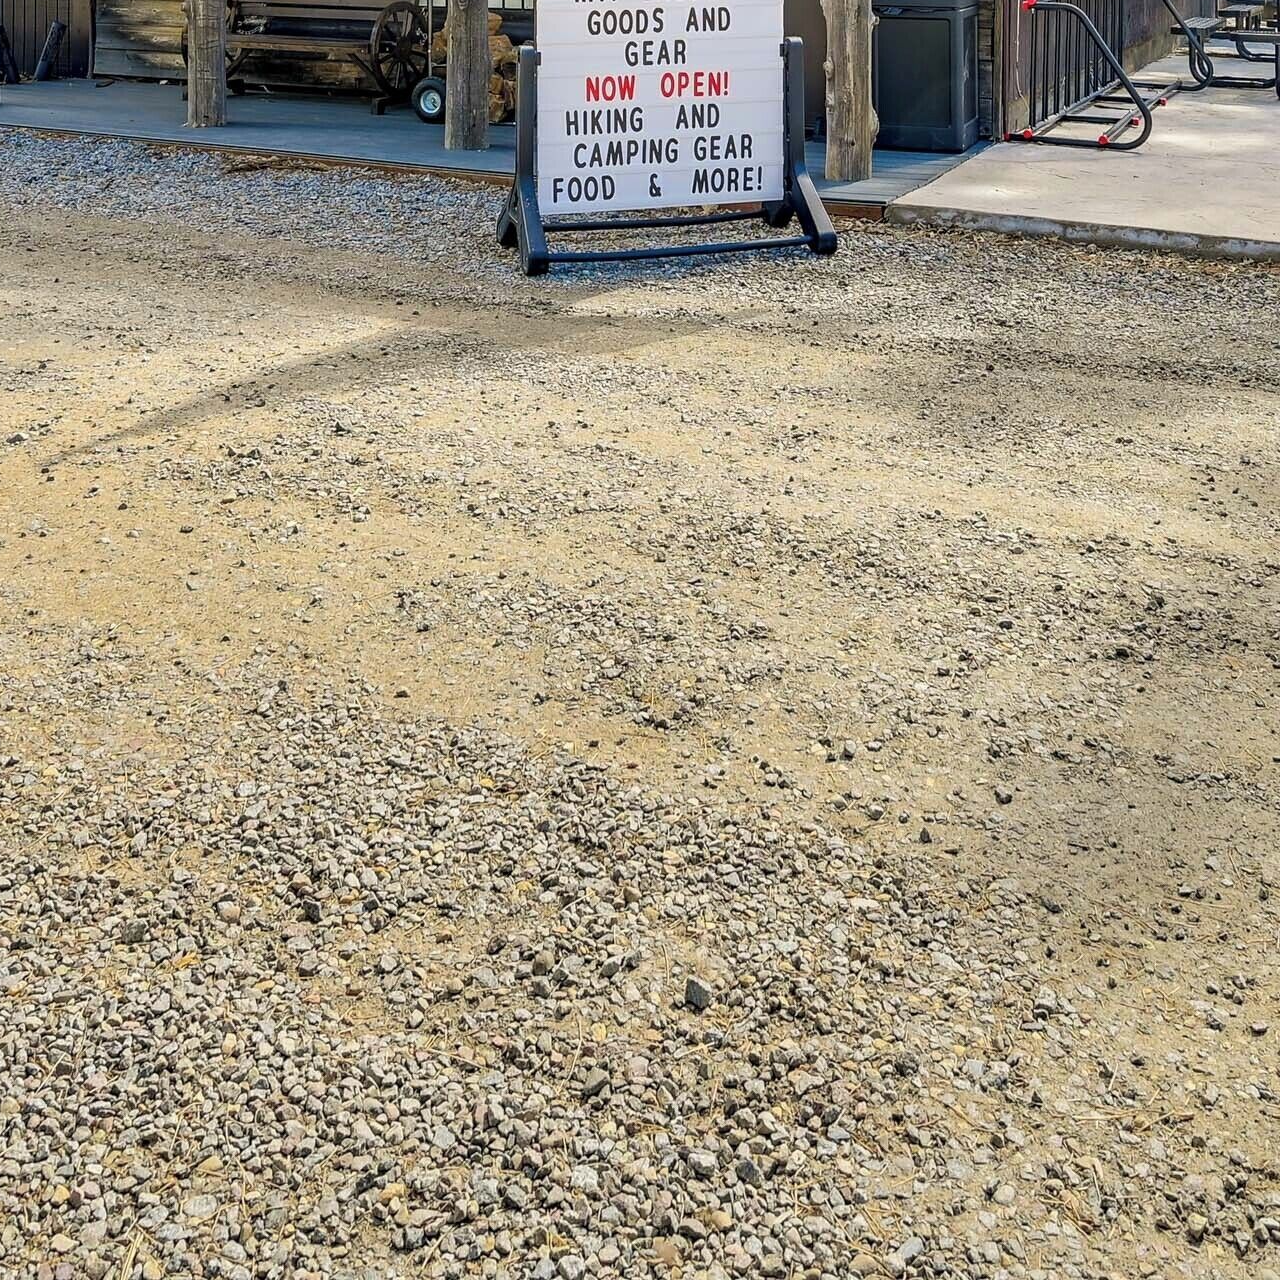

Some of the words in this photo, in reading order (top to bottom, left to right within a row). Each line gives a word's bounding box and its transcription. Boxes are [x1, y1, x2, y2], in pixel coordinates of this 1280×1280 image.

[587, 7, 664, 36] GOODS
[686, 7, 731, 32] AND
[625, 39, 687, 67] GEAR
[585, 75, 636, 102] NOW
[660, 71, 730, 98] OPEN!
[565, 107, 644, 136] HIKING
[675, 103, 720, 130] AND
[573, 138, 679, 169] CAMPING
[694, 133, 753, 161] GEAR
[552, 175, 616, 204] FOOD
[648, 173, 663, 198] &
[691, 166, 763, 195] MORE!
